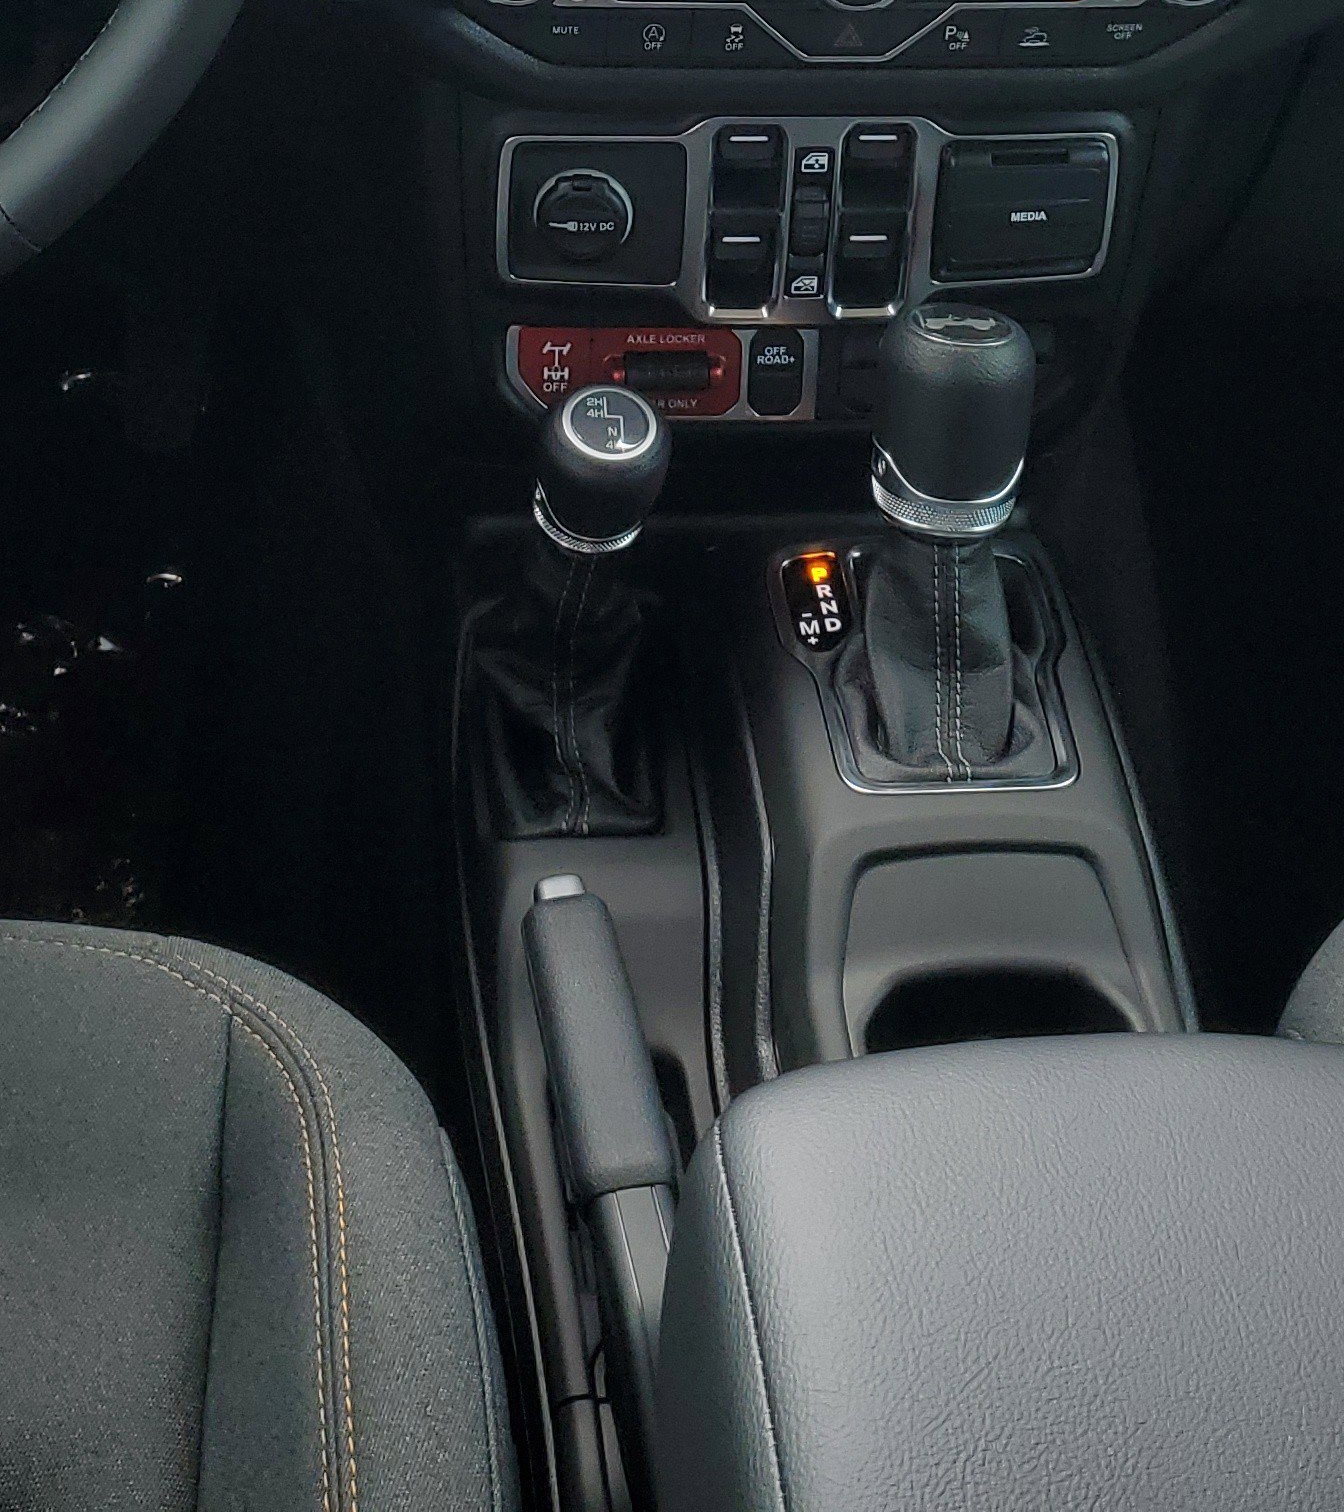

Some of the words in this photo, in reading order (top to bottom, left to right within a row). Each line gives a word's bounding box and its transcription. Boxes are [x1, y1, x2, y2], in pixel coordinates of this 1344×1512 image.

[552, 25, 580, 35] MUTE
[1106, 23, 1143, 33] SCREEN
[1113, 31, 1133, 40] OFF
[643, 41, 663, 51] OFF
[724, 41, 744, 52] OFF
[949, 41, 967, 51] OFF
[1010, 209, 1047, 222] MEDIA
[579, 222, 597, 231] 12V
[599, 221, 615, 231] DC
[626, 333, 656, 345] AXLE
[659, 333, 706, 345] LOCKER
[764, 345, 787, 356] OFF
[756, 354, 796, 366] ROAD+
[542, 382, 568, 392] OFF
[586, 397, 603, 406] 2H
[668, 398, 698, 409] ONLY
[586, 408, 604, 418] 4H
[811, 567, 828, 583] P
[816, 584, 834, 599] R
[820, 599, 839, 616] N
[799, 619, 821, 636] M
[824, 617, 842, 632] D
